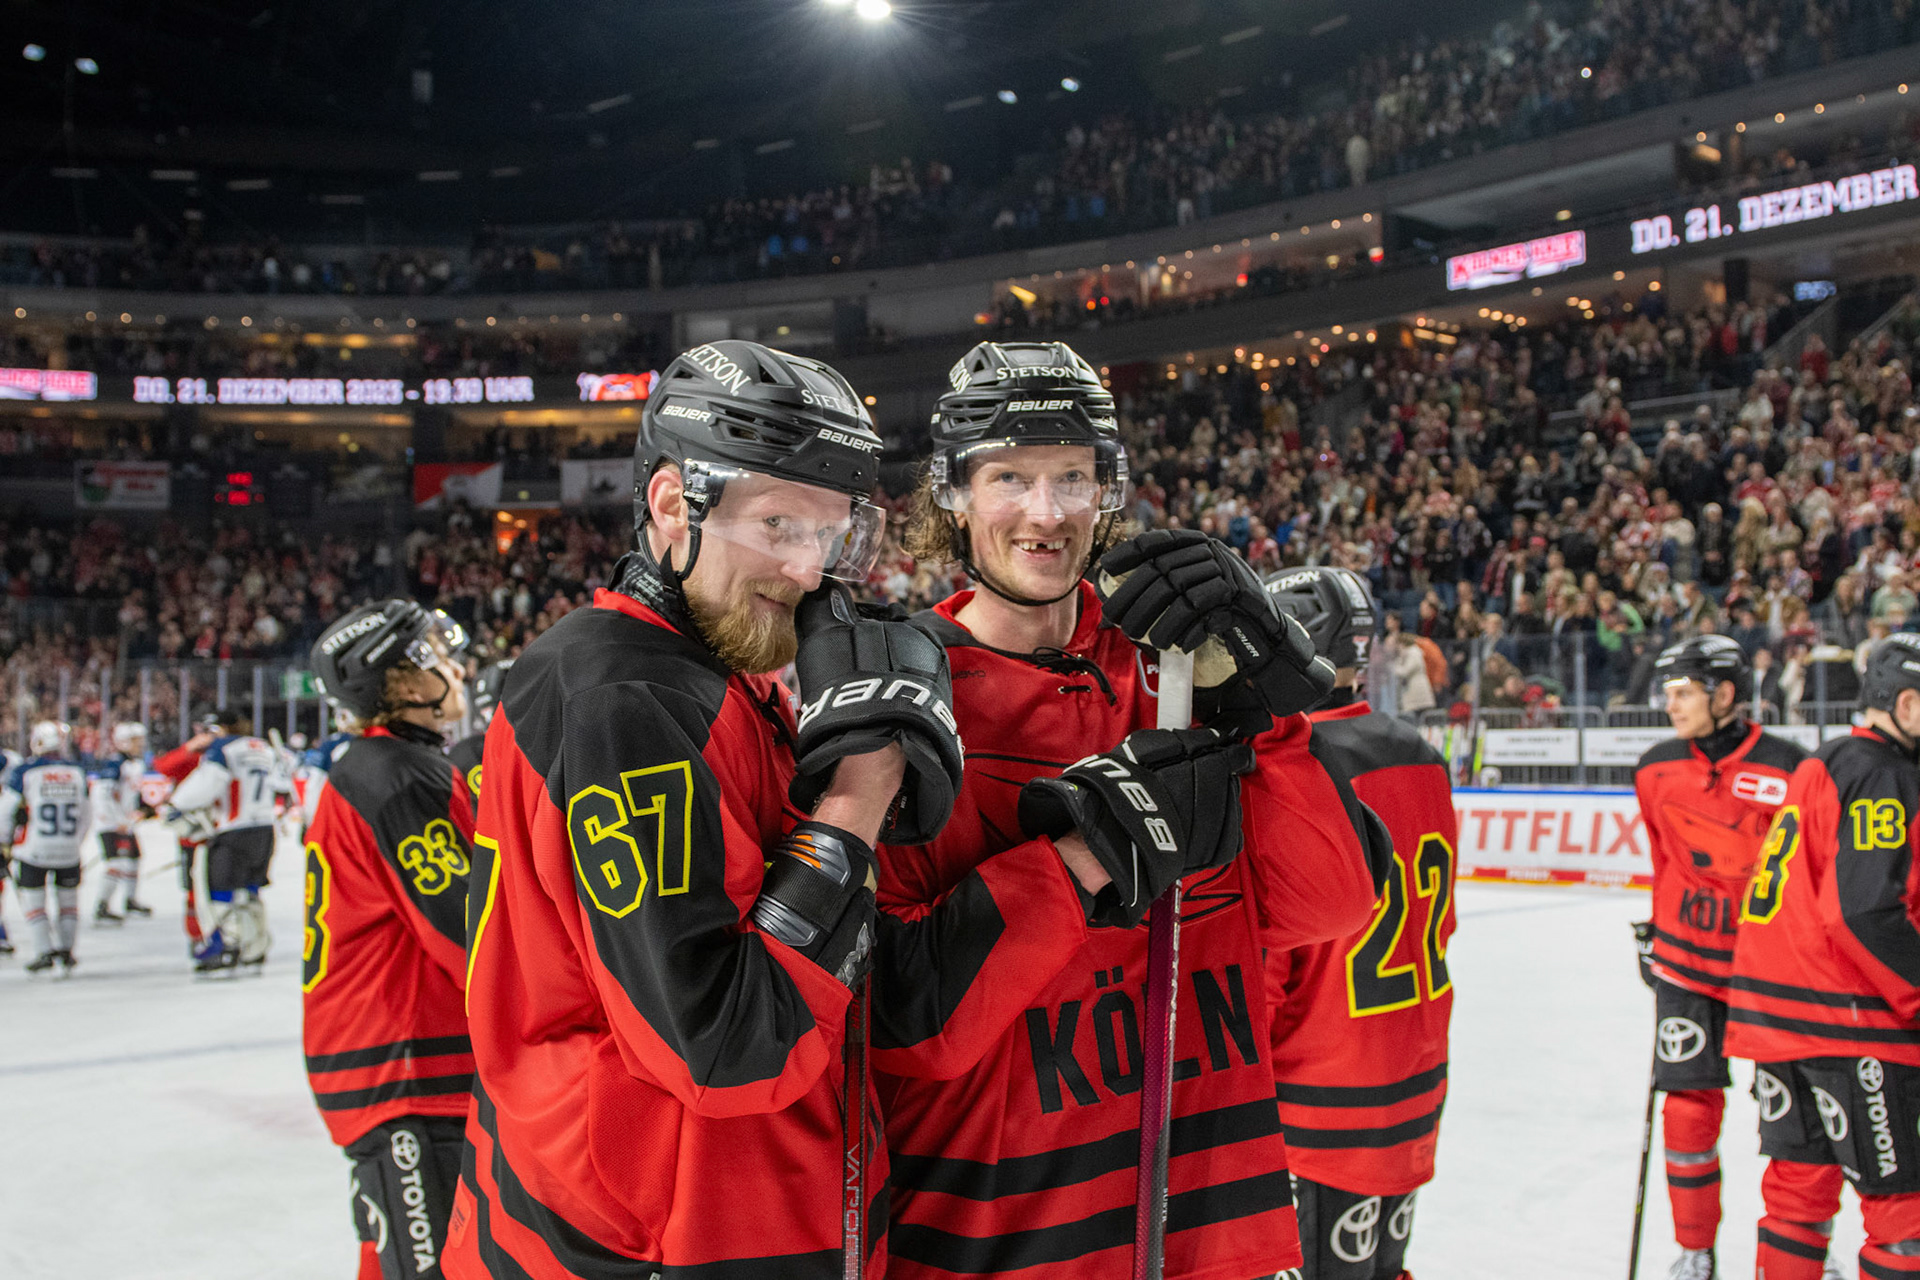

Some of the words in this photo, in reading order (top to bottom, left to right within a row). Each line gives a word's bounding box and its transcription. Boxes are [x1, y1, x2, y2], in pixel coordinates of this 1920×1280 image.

[1631, 215, 1680, 254] DO.
[1684, 204, 1733, 243] 21.
[1738, 164, 1919, 232] DEZEMBER
[177, 377, 216, 404] 21.
[217, 378, 344, 404] DEZEMBER
[996, 365, 1079, 381] STETSON
[1006, 400, 1073, 412] BAUER
[322, 612, 387, 655] STETSON
[39, 803, 79, 836] 95
[566, 760, 694, 919] 67
[1849, 798, 1906, 851] 13
[397, 817, 471, 896] 33
[1865, 1091, 1898, 1178] TOYOTA
[401, 1169, 436, 1273] TOYOTA
